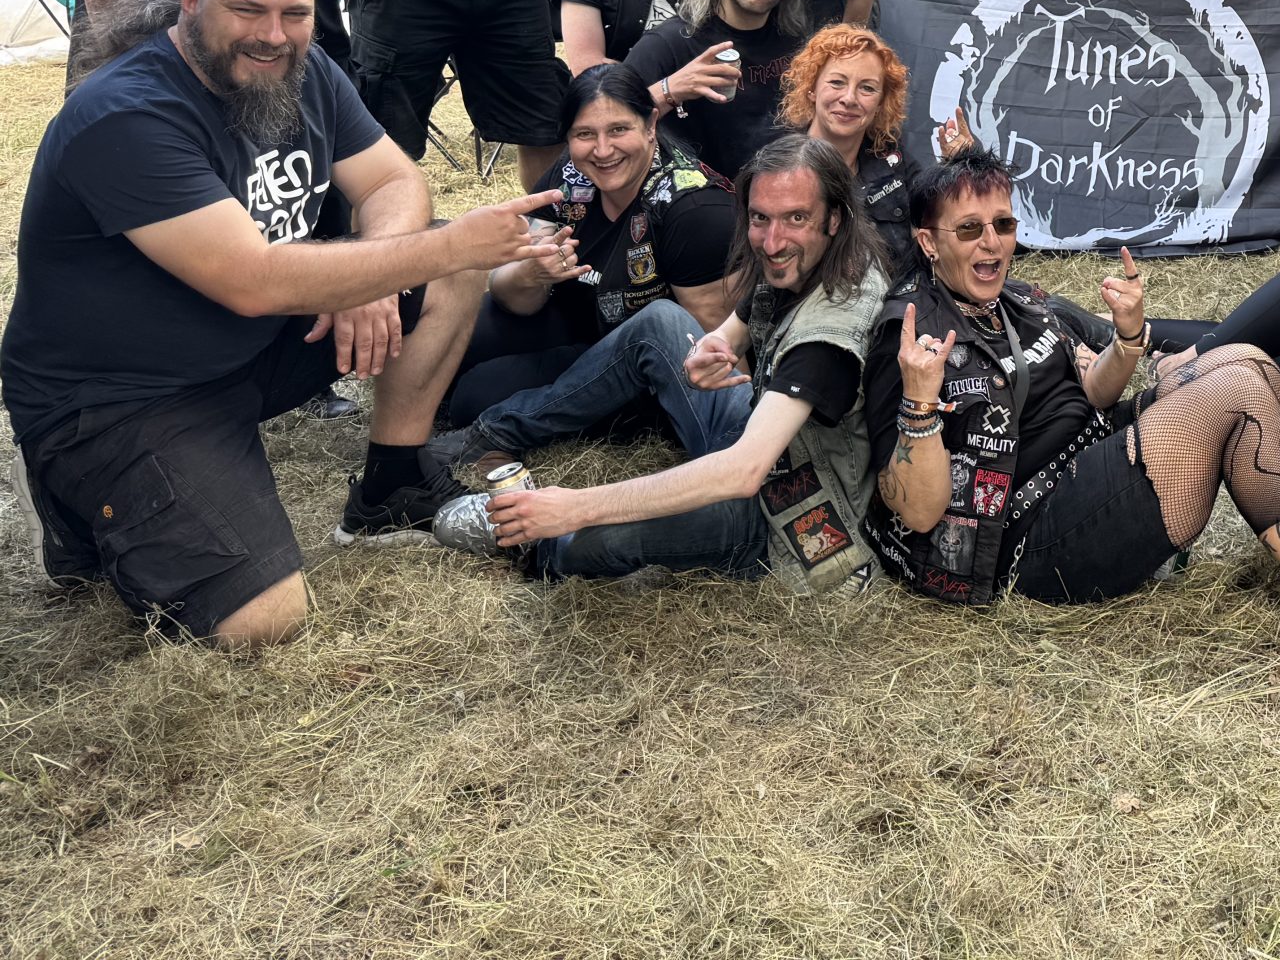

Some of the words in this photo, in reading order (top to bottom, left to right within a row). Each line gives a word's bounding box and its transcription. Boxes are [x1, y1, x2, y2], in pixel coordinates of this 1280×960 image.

[1034, 3, 1176, 94] Tunes
[1088, 96, 1122, 132] of
[944, 376, 993, 403] TALLICA
[967, 433, 1016, 453] METALITY
[793, 506, 829, 535] AC/DC
